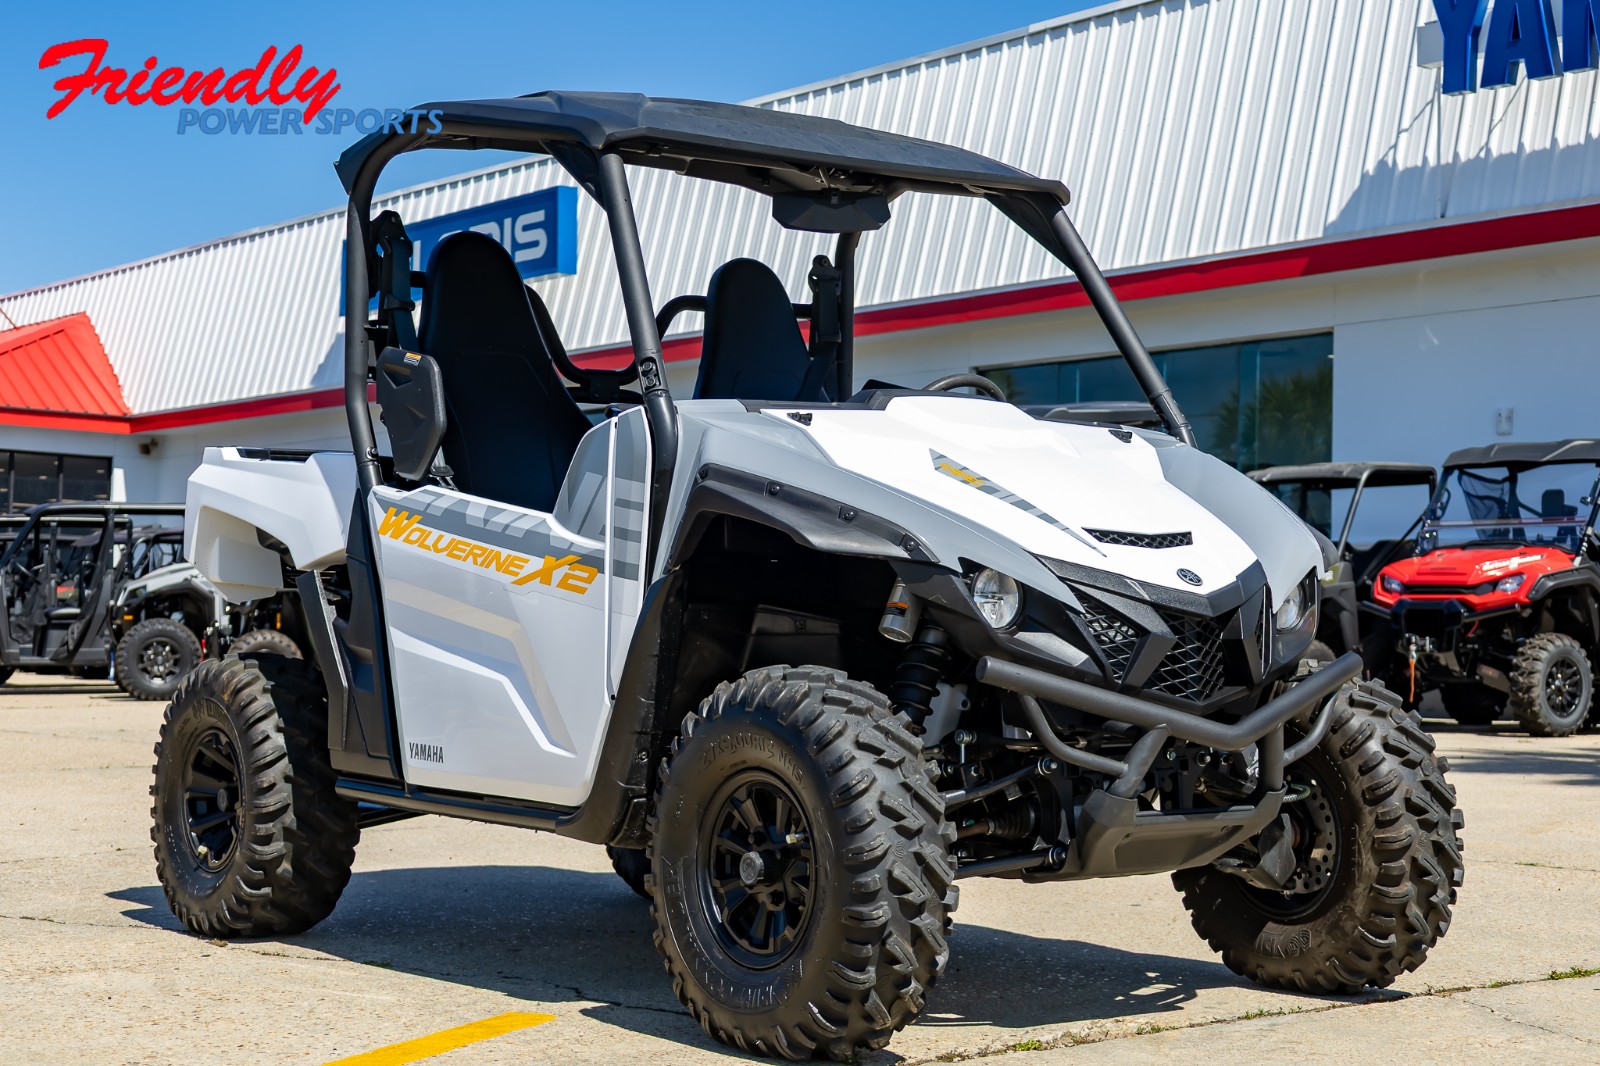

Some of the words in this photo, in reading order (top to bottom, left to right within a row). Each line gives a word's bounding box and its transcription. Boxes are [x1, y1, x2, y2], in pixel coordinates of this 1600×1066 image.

[377, 506, 530, 577] WOLVERINE
[511, 554, 599, 595] X2
[409, 742, 444, 764] YAMAHA
